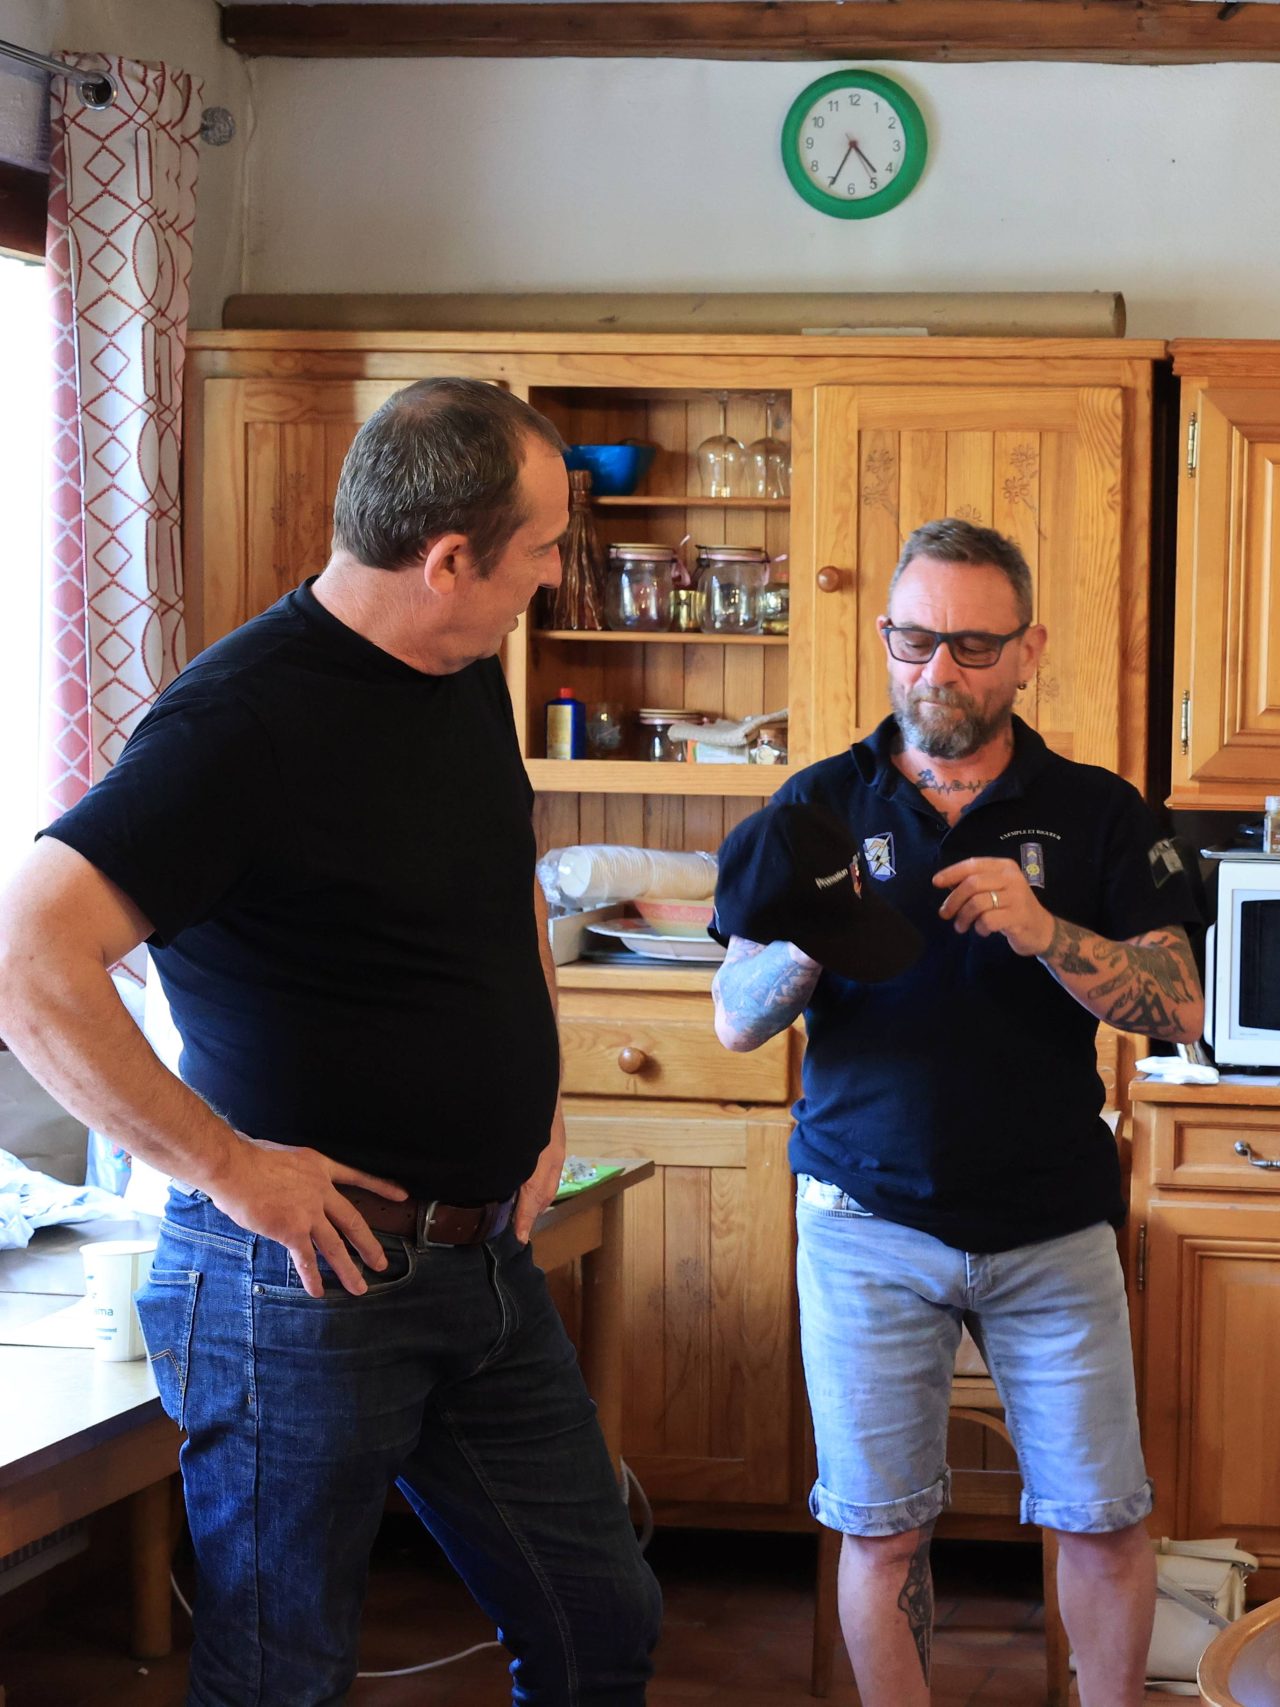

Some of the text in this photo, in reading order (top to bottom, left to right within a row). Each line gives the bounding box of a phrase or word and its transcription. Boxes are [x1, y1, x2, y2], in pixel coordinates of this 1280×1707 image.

[848, 93, 861, 106] 12
[828, 101, 839, 112] 11
[874, 102, 879, 113] 1
[812, 116, 825, 128] 10
[888, 117, 896, 129] 2
[806, 137, 814, 149] 9
[893, 140, 901, 152] 3
[811, 160, 819, 172] 8
[885, 162, 893, 173] 4
[847, 183, 855, 195] 6
[870, 177, 877, 190] 5
